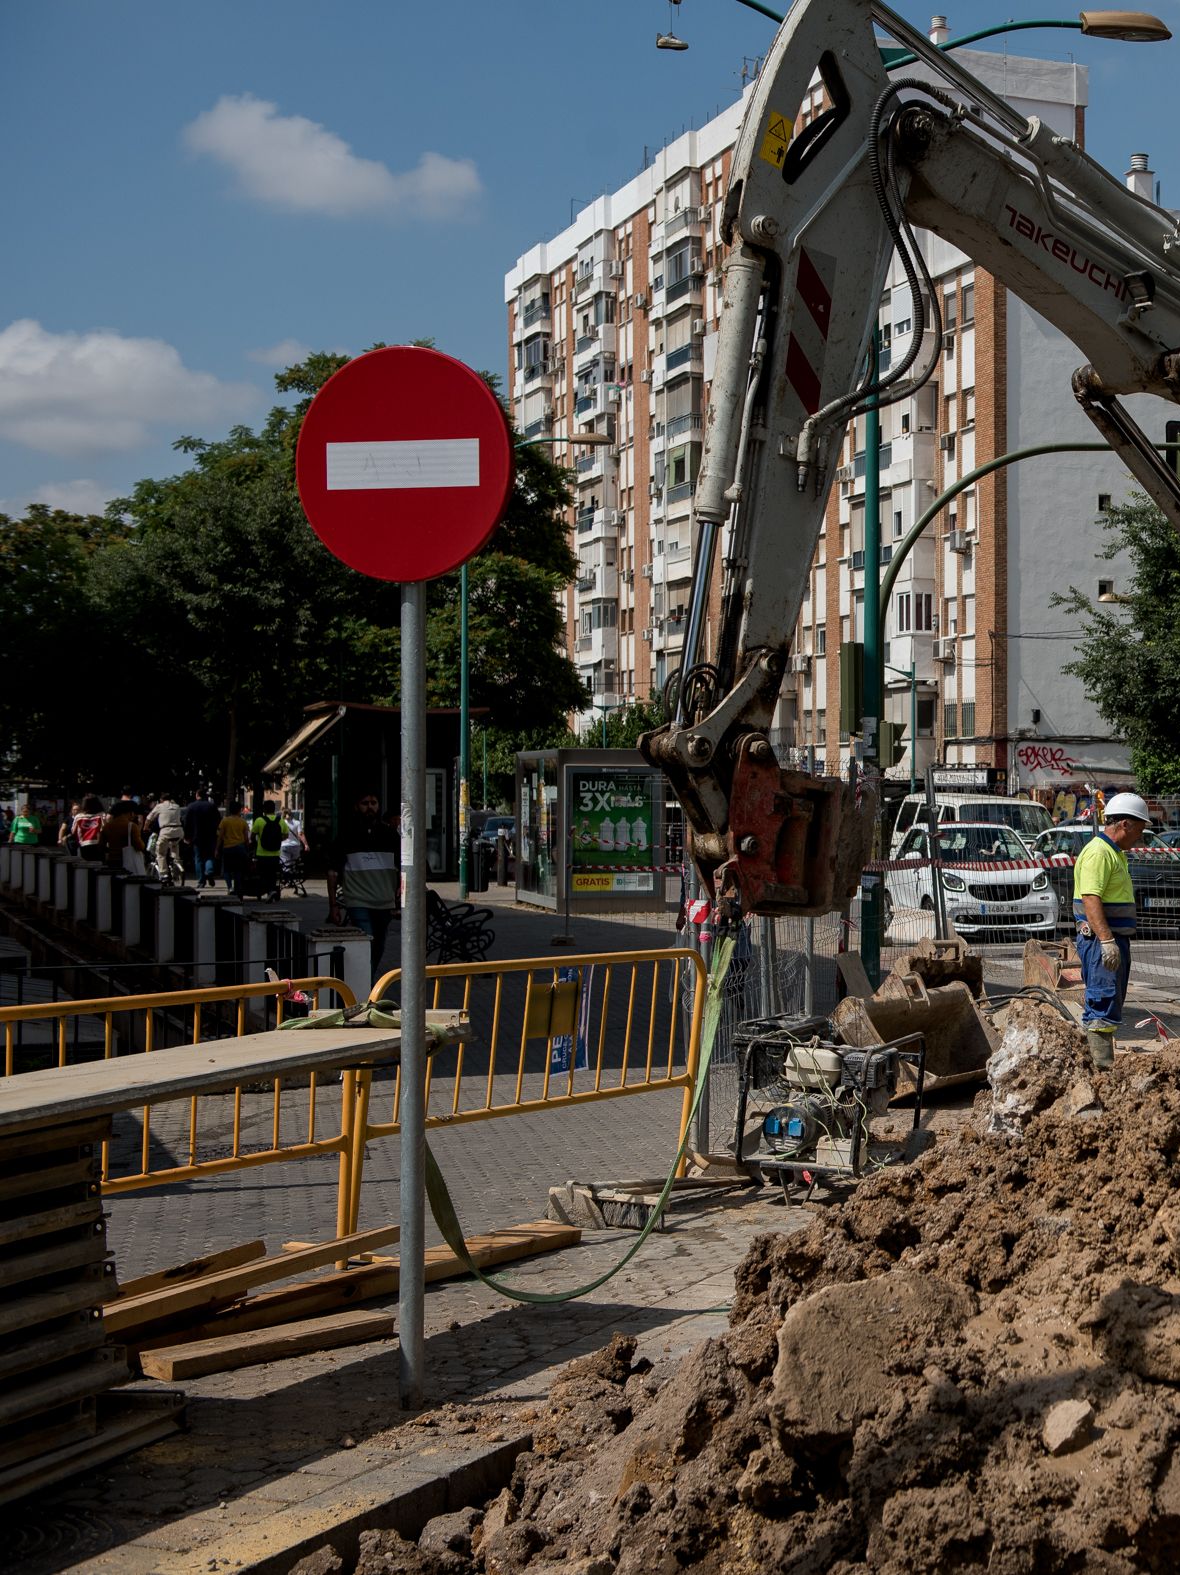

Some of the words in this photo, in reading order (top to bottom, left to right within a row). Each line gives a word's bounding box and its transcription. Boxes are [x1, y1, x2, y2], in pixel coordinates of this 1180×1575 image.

[580, 781, 616, 791] DURA
[580, 792, 611, 811] 3X
[576, 878, 610, 887] GRATIS
